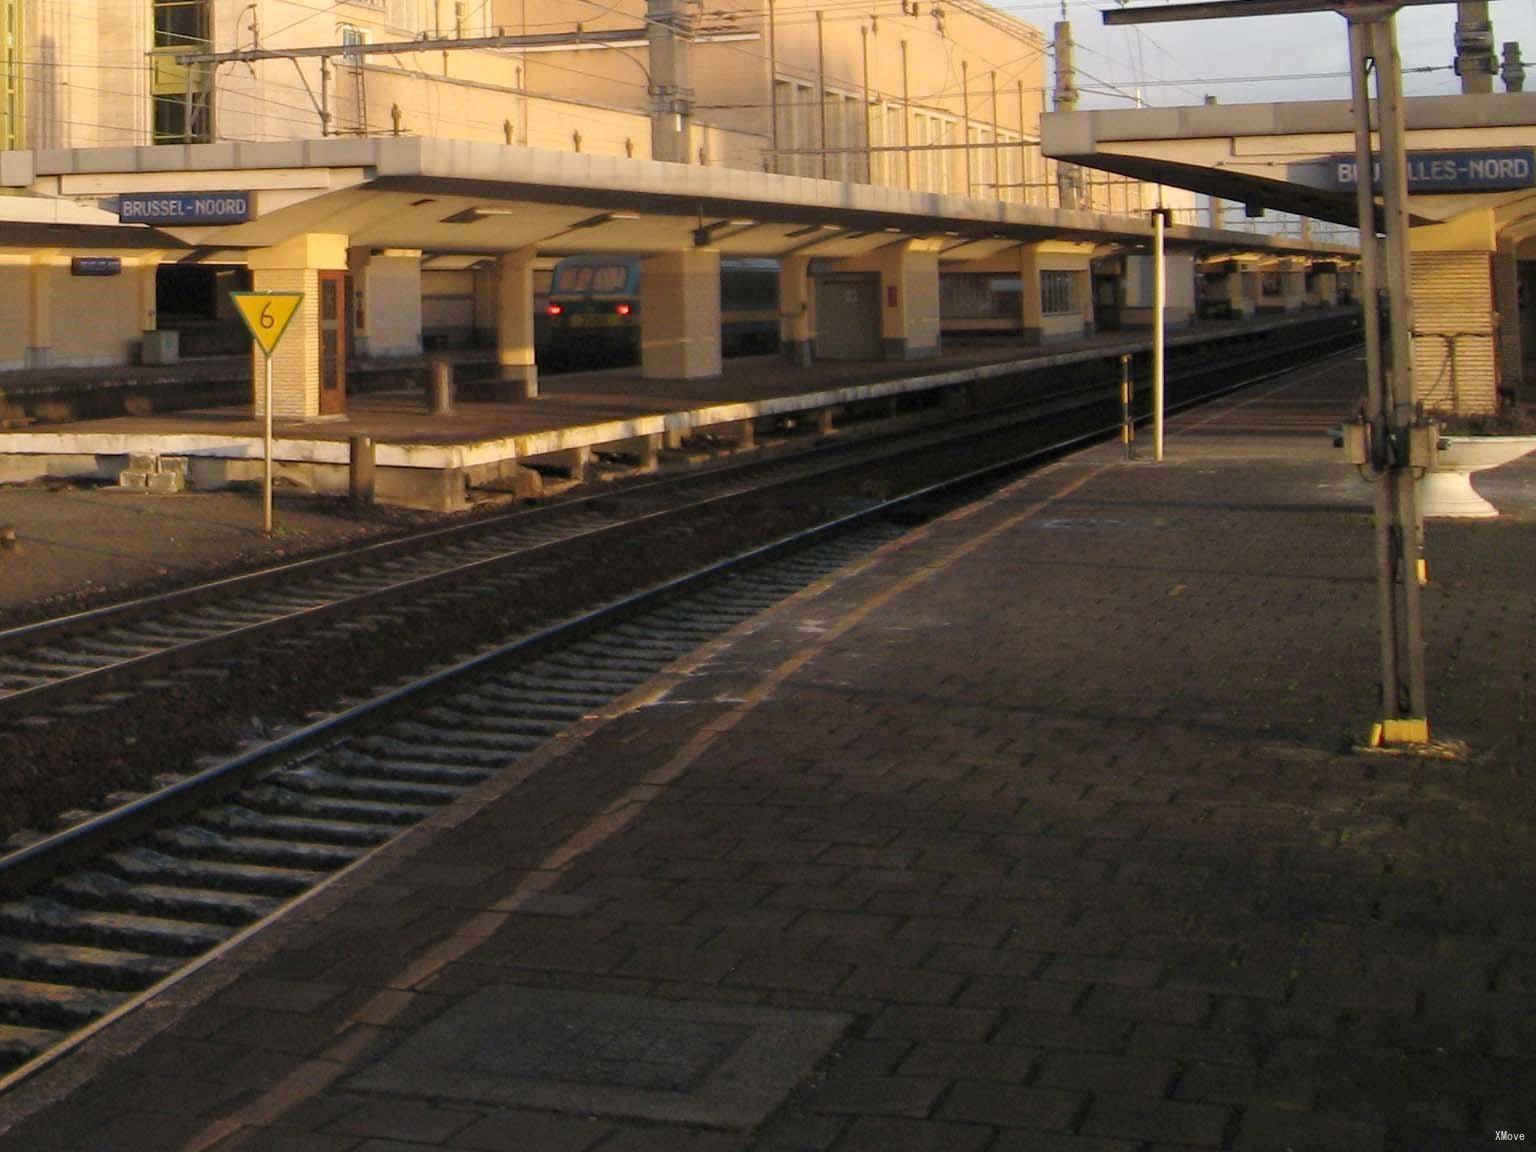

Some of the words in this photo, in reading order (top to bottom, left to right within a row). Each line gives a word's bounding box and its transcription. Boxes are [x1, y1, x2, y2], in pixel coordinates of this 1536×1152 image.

[1337, 158, 1529, 182] BLLES-NORD
[122, 198, 247, 217] BRUSSEL-NOORD
[260, 300, 274, 329] 6
